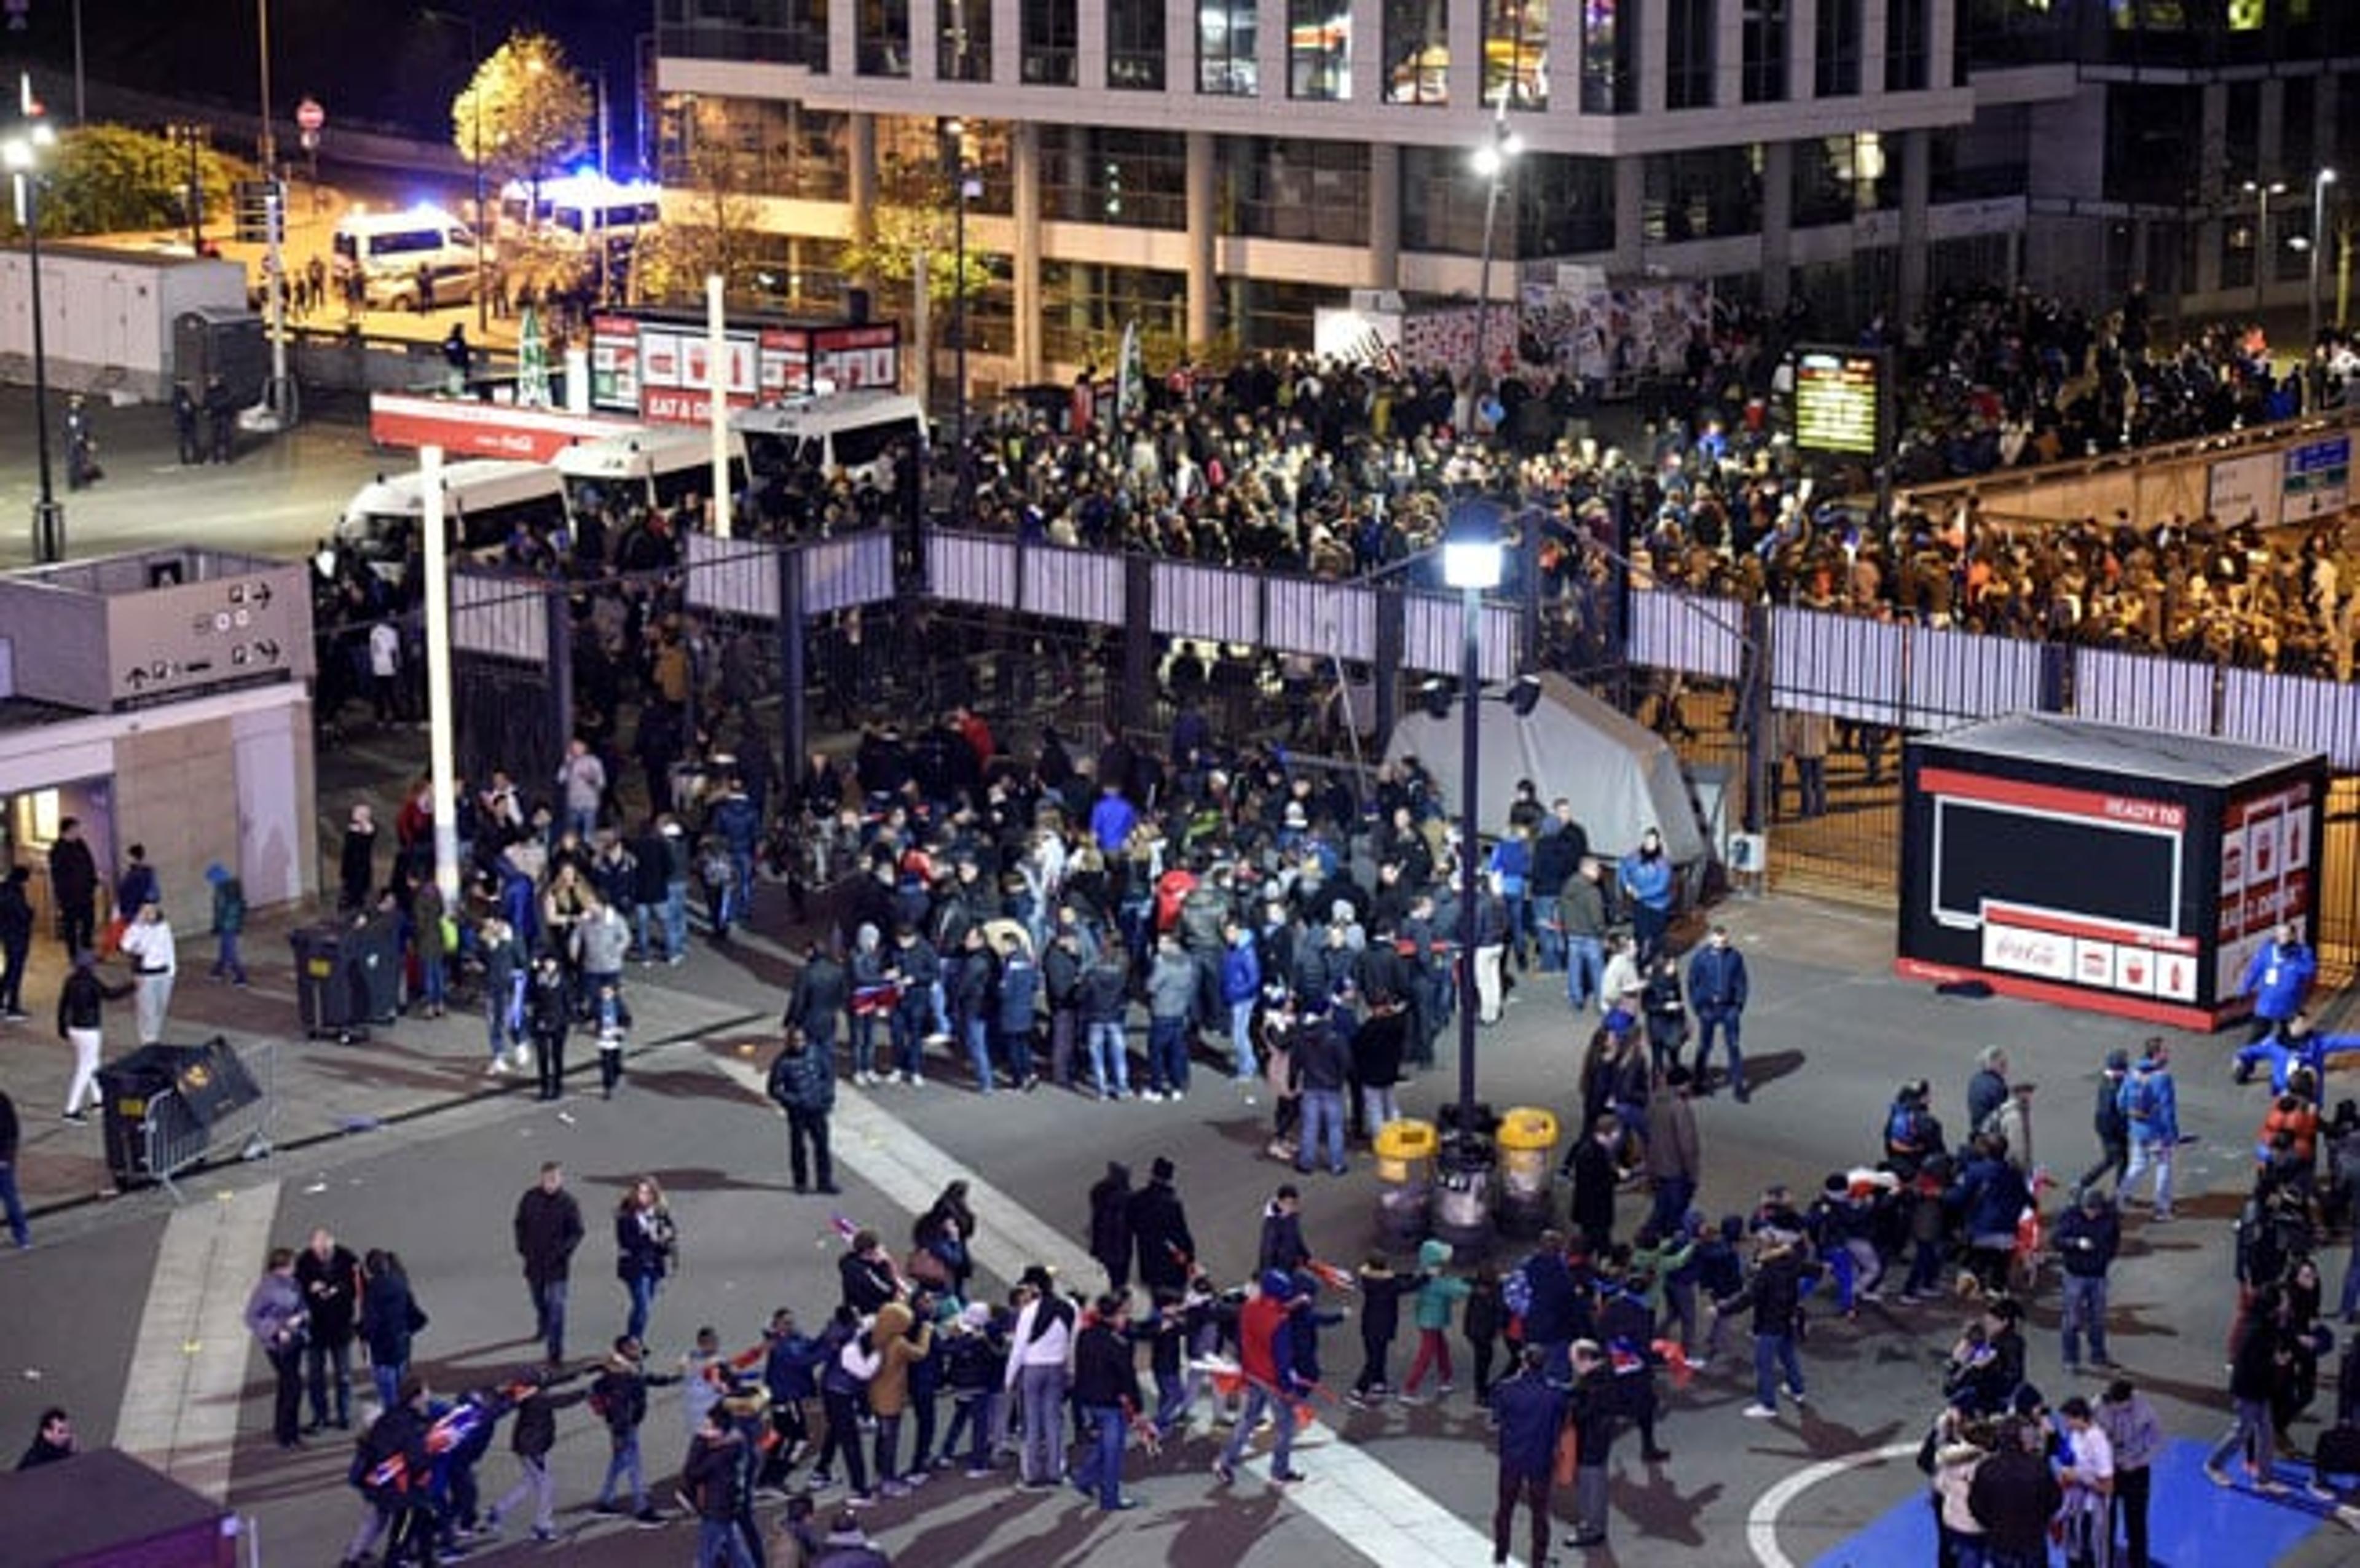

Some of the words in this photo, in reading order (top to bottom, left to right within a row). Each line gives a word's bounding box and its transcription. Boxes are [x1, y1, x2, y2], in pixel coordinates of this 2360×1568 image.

[649, 396, 677, 417] EAT
[2105, 798, 2157, 821] READY
[2158, 804, 2181, 825] TO
